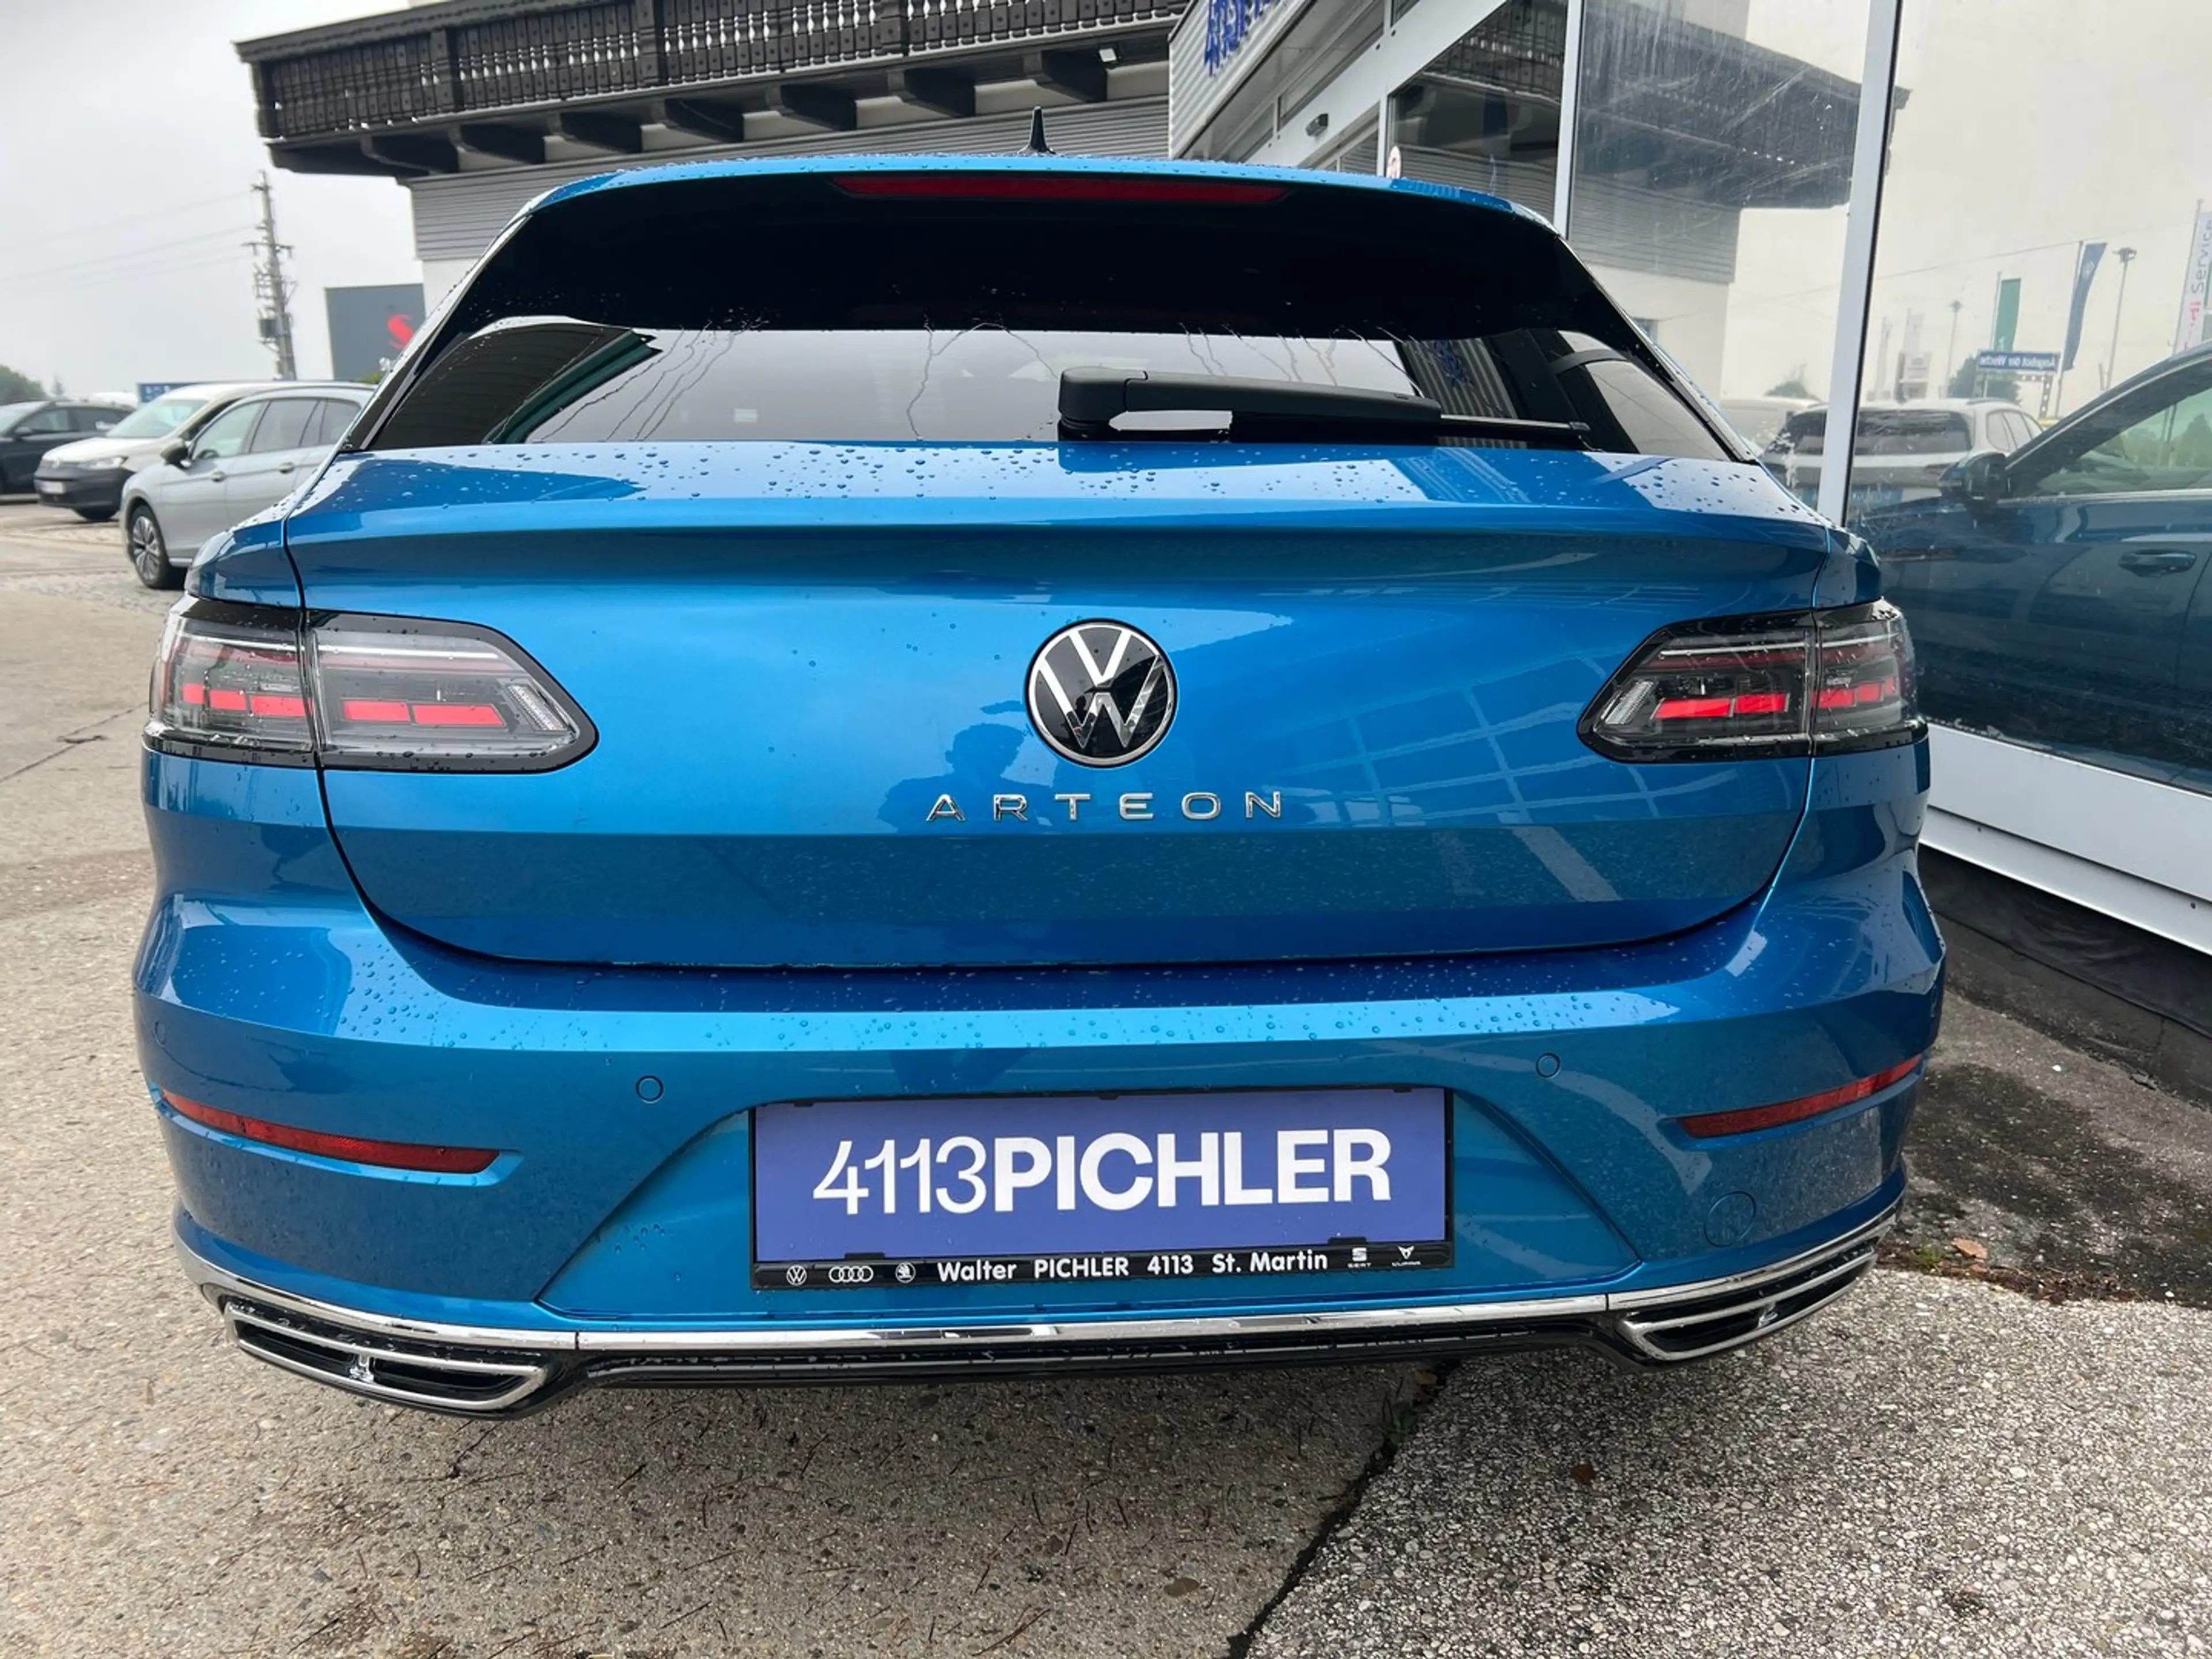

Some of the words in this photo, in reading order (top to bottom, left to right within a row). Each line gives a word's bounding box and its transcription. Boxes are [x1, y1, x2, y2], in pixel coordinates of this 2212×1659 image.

[926, 791, 1281, 821] ARTEON
[937, 1259, 1017, 1282] Walter
[1034, 1256, 1129, 1279] PICHLER
[1147, 1254, 1194, 1275] 4113
[1212, 1253, 1241, 1273] St.
[1250, 1249, 1328, 1272] Martin
